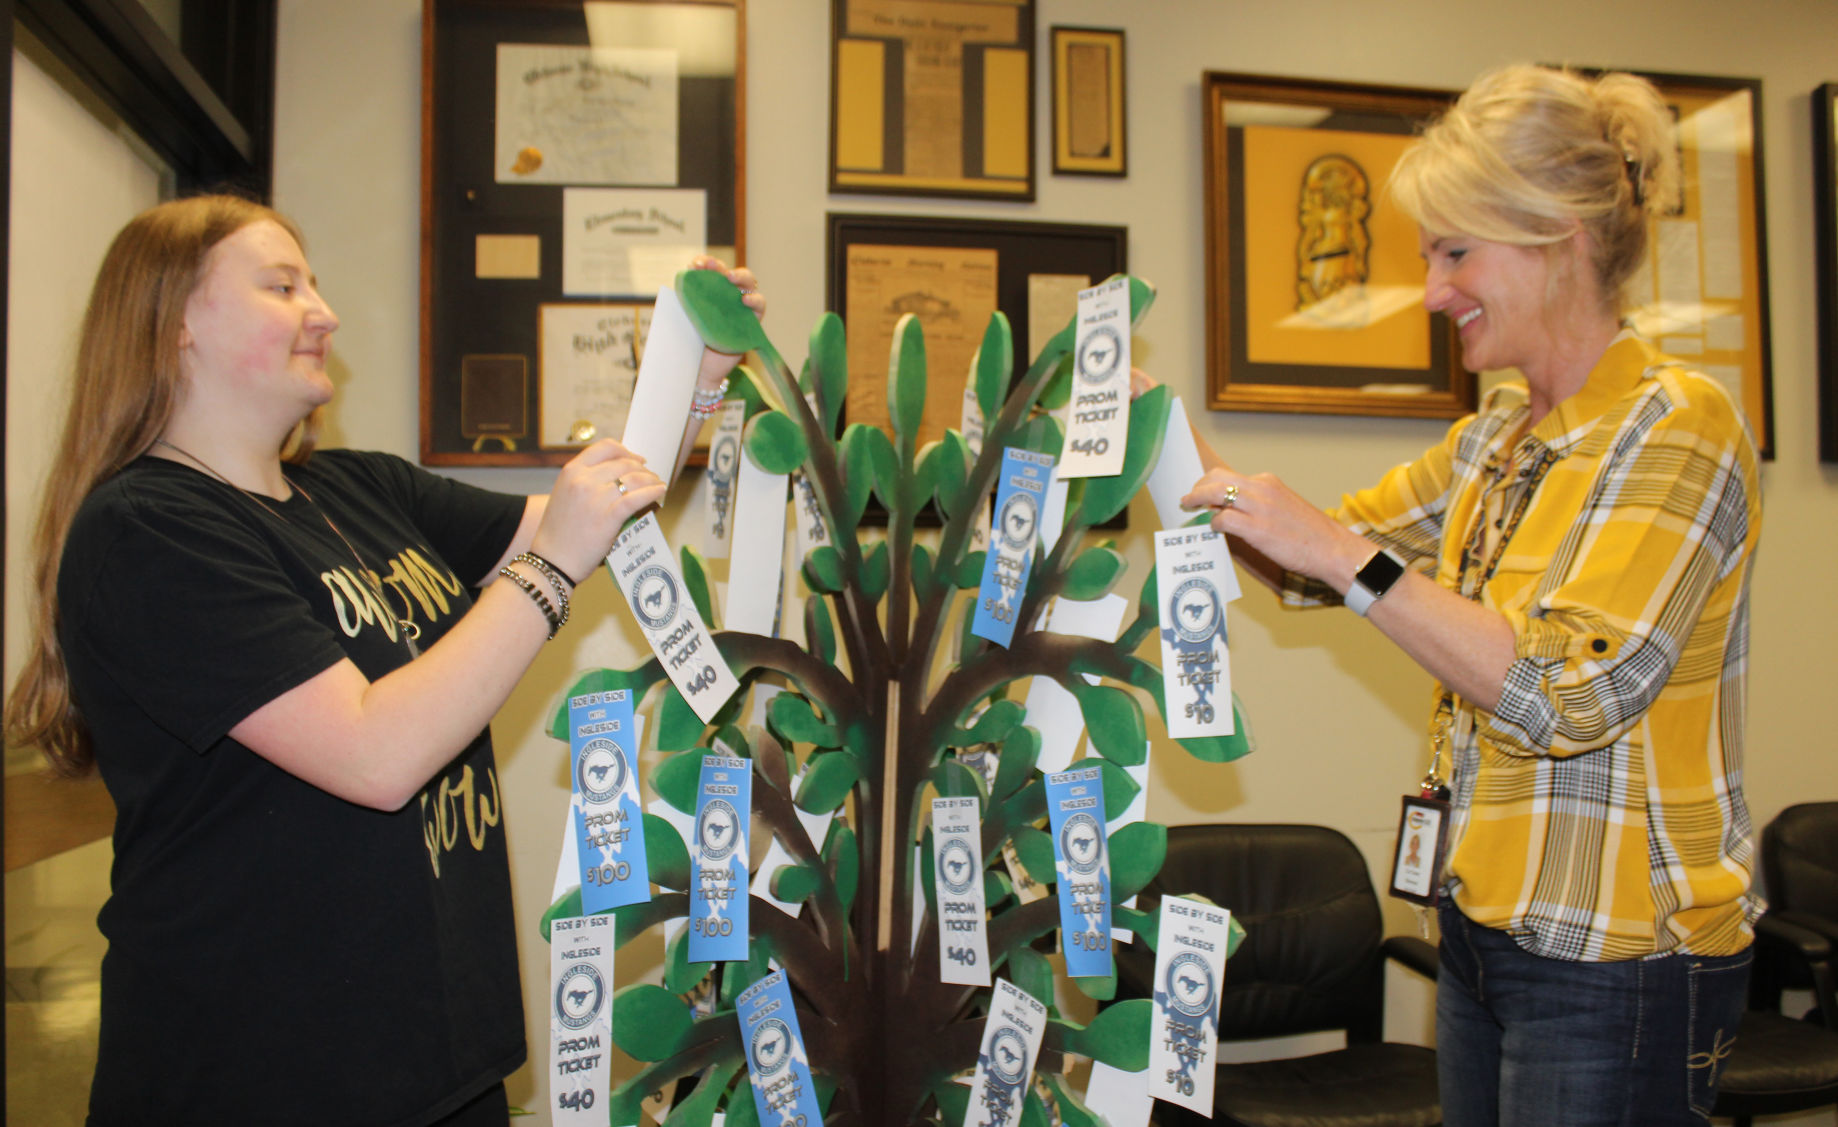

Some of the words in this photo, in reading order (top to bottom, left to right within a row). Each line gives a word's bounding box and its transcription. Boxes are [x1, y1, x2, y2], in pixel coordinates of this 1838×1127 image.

[1076, 390, 1118, 407] PROM
[1075, 407, 1119, 425] TICKET
[1070, 437, 1110, 456] $40
[611, 538, 621, 552] DE
[996, 555, 1026, 574] PROM
[992, 571, 1023, 591] TICKET
[984, 597, 1015, 625] $100
[660, 619, 694, 655] PROM
[670, 633, 703, 670] TICKET
[1176, 650, 1221, 668] PROM
[686, 665, 717, 696] $40
[1176, 669, 1222, 687] TICKET
[572, 697, 588, 708] SIDE
[589, 694, 602, 705] BY
[604, 690, 625, 702] SIDE
[1184, 703, 1216, 725] $10
[578, 720, 621, 737] INGLESIDE
[584, 809, 629, 829] PROM
[585, 829, 631, 850] TICKET
[586, 860, 632, 887] $100
[699, 868, 737, 882] PROM
[698, 887, 737, 901] TICKET
[1070, 882, 1106, 896] PROM
[944, 902, 977, 914] PROM
[1072, 901, 1107, 915] TICKET
[555, 920, 573, 932] SIDE
[575, 918, 588, 929] BY
[590, 916, 609, 928] SIDE
[695, 917, 734, 938] $100
[945, 919, 978, 932] TICKET
[1072, 930, 1107, 952] $100
[561, 946, 602, 960] INGLESIDE
[947, 946, 976, 967] $40
[1164, 1018, 1208, 1045] PROM
[558, 1034, 601, 1056] PROM
[1163, 1037, 1208, 1064] TICKET
[557, 1053, 603, 1076] TICKET
[763, 1070, 800, 1101] PROM
[1165, 1068, 1196, 1098] $10
[558, 1088, 596, 1112] $40
[765, 1085, 803, 1116] TICKET
[983, 1079, 1016, 1110] PROM
[980, 1093, 1013, 1126] TICKET
